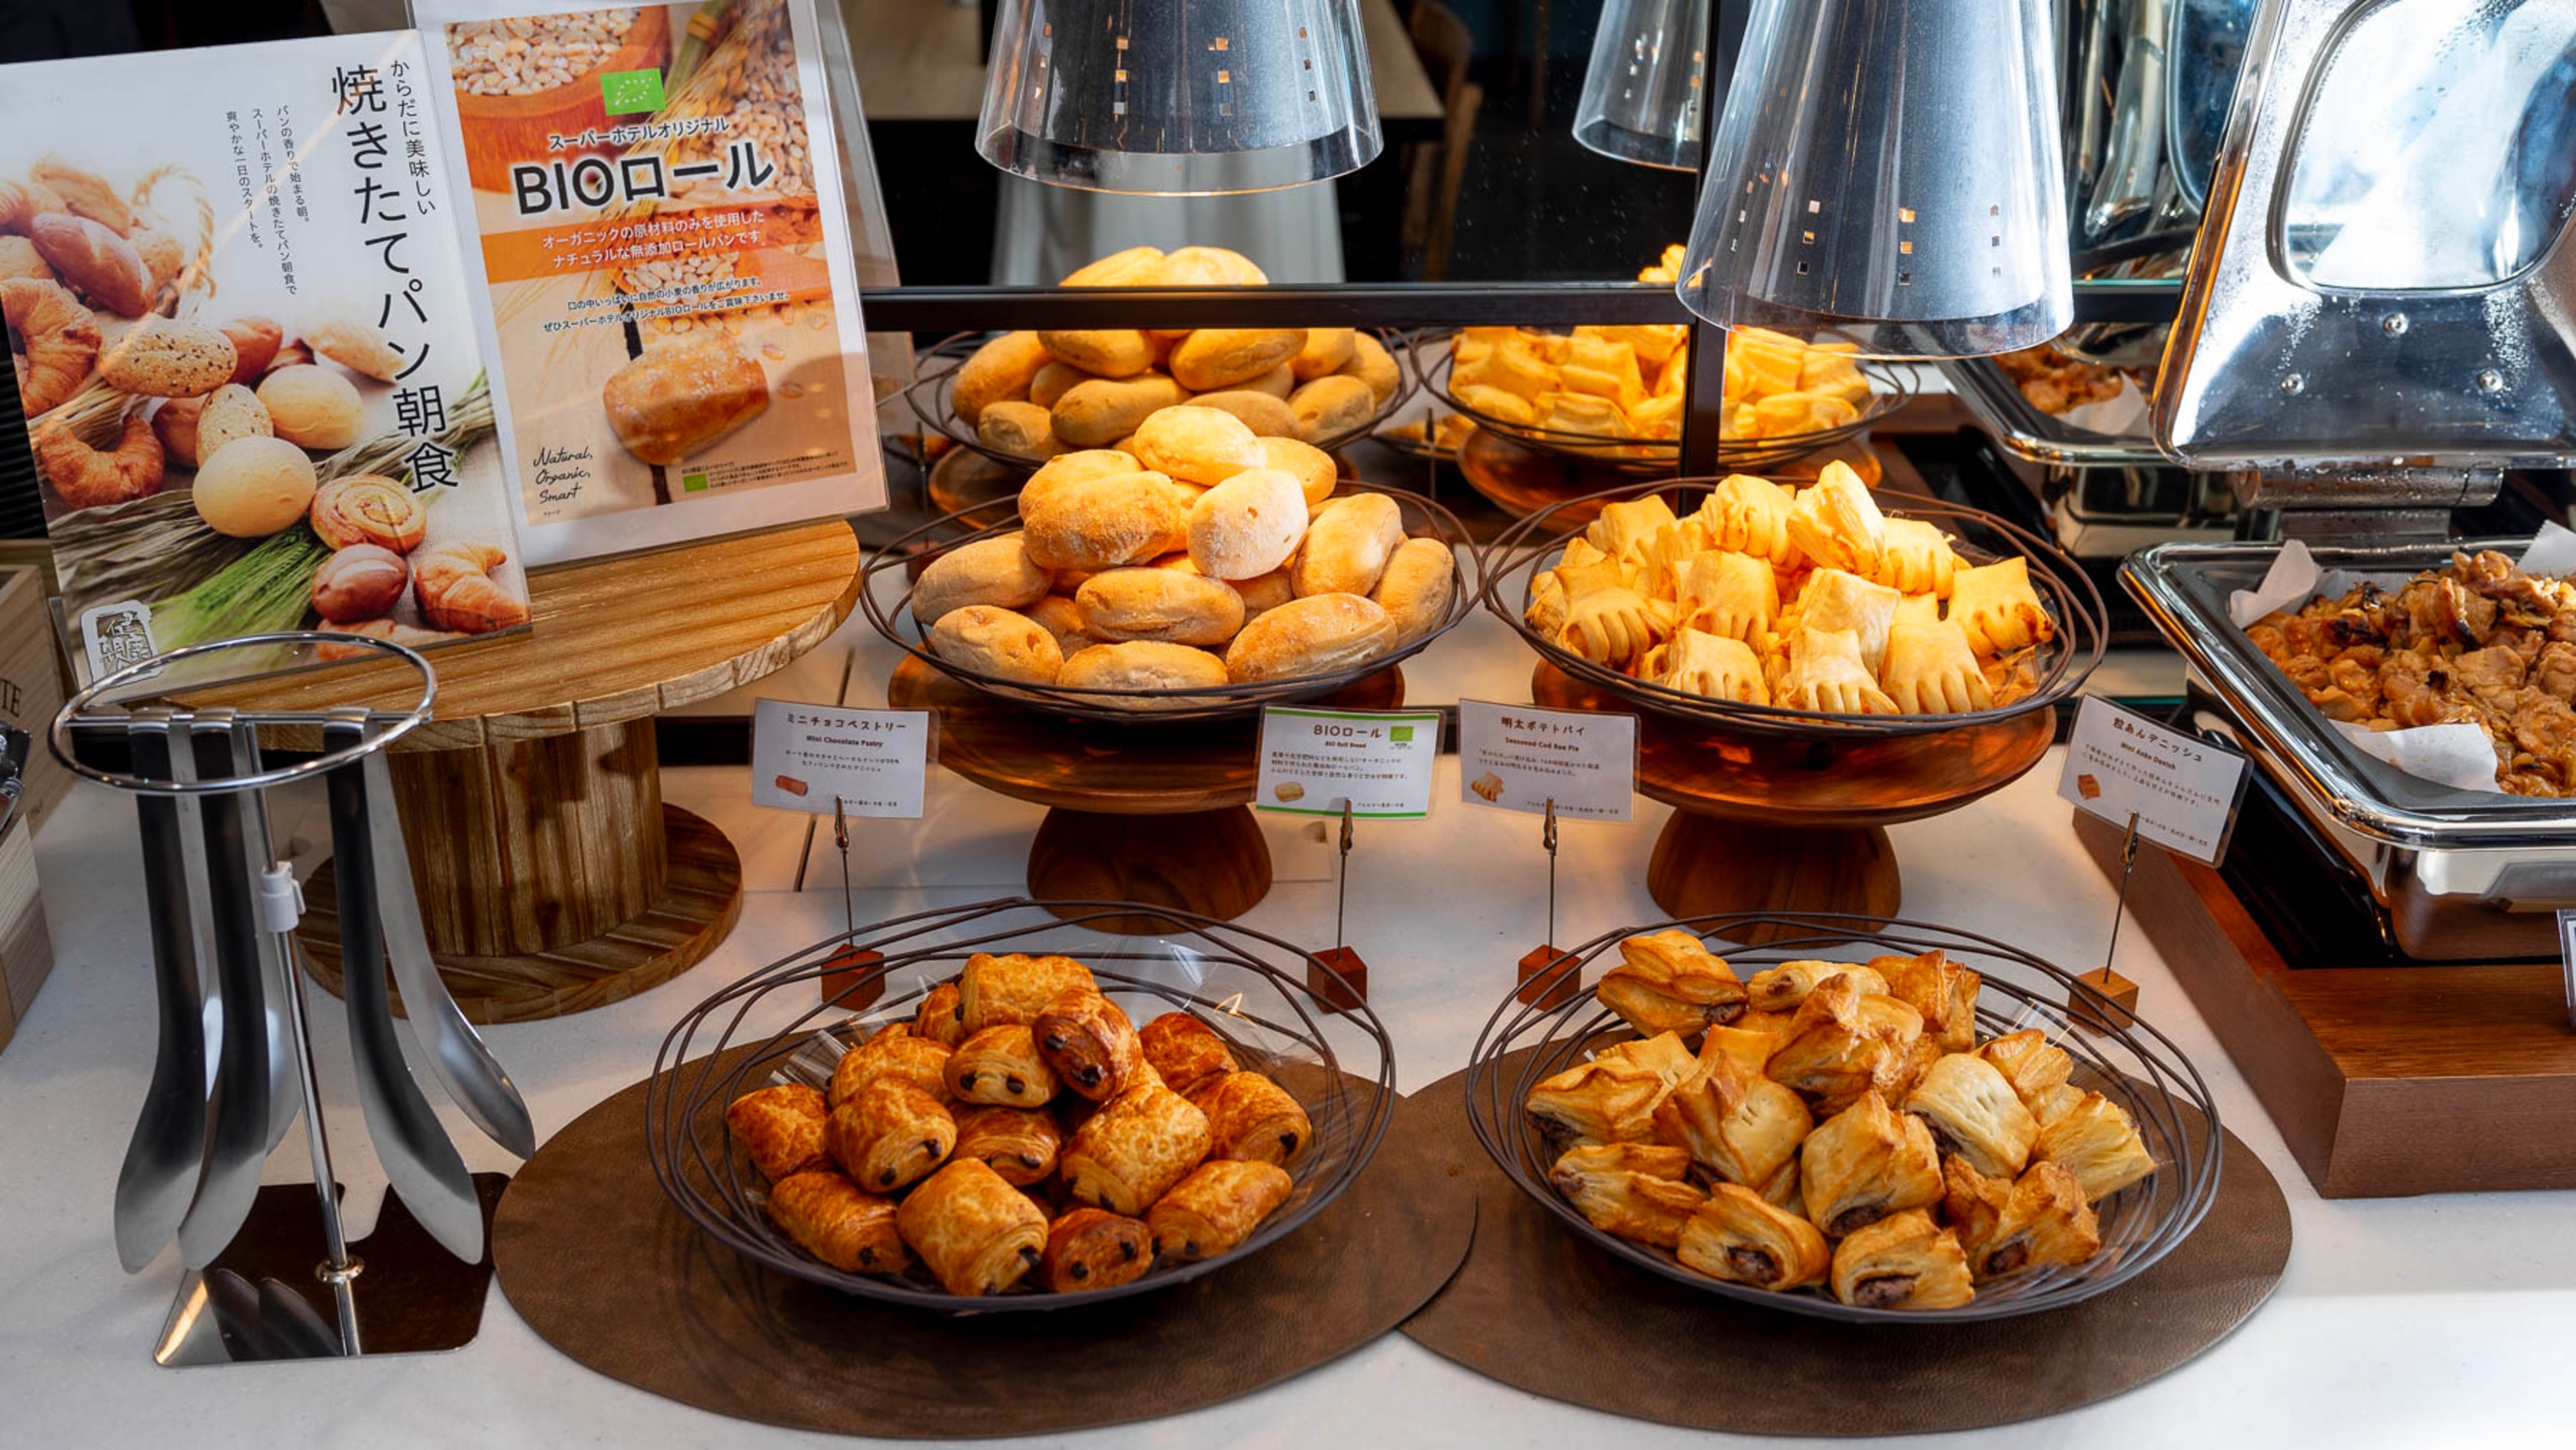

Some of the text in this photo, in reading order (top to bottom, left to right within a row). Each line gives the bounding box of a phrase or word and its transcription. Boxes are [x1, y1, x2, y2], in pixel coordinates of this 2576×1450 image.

[391, 59, 437, 216] からだに美味しい
[549, 116, 730, 151] スーパーホテルオリジナル
[226, 111, 263, 248] 爽やかな一日のスタートを。
[277, 105, 310, 223] パンの香りで始まる朝。
[514, 143, 774, 215] BIOロール
[252, 108, 298, 295] スーパーホテルの焼きたてパン朝食で
[542, 210, 765, 250] オーガニックの原材料のみを使用した
[332, 65, 460, 495] 焼きたてパン朝食
[533, 446, 593, 467] Natural,
[536, 466, 590, 485] Organic,
[540, 481, 583, 504] Smart
[823, 736, 859, 747] Chocolate
[861, 739, 883, 748] Pastry
[1313, 724, 1383, 739] BIOロール
[1501, 717, 1586, 736] 明太ポテトパイ
[1505, 736, 1537, 748] Seasoned
[1538, 740, 1552, 750] Cod
[2113, 718, 2202, 762] 粒あんデニッシュ
[2120, 741, 2135, 755] Mini
[2154, 754, 2177, 771] Danish
